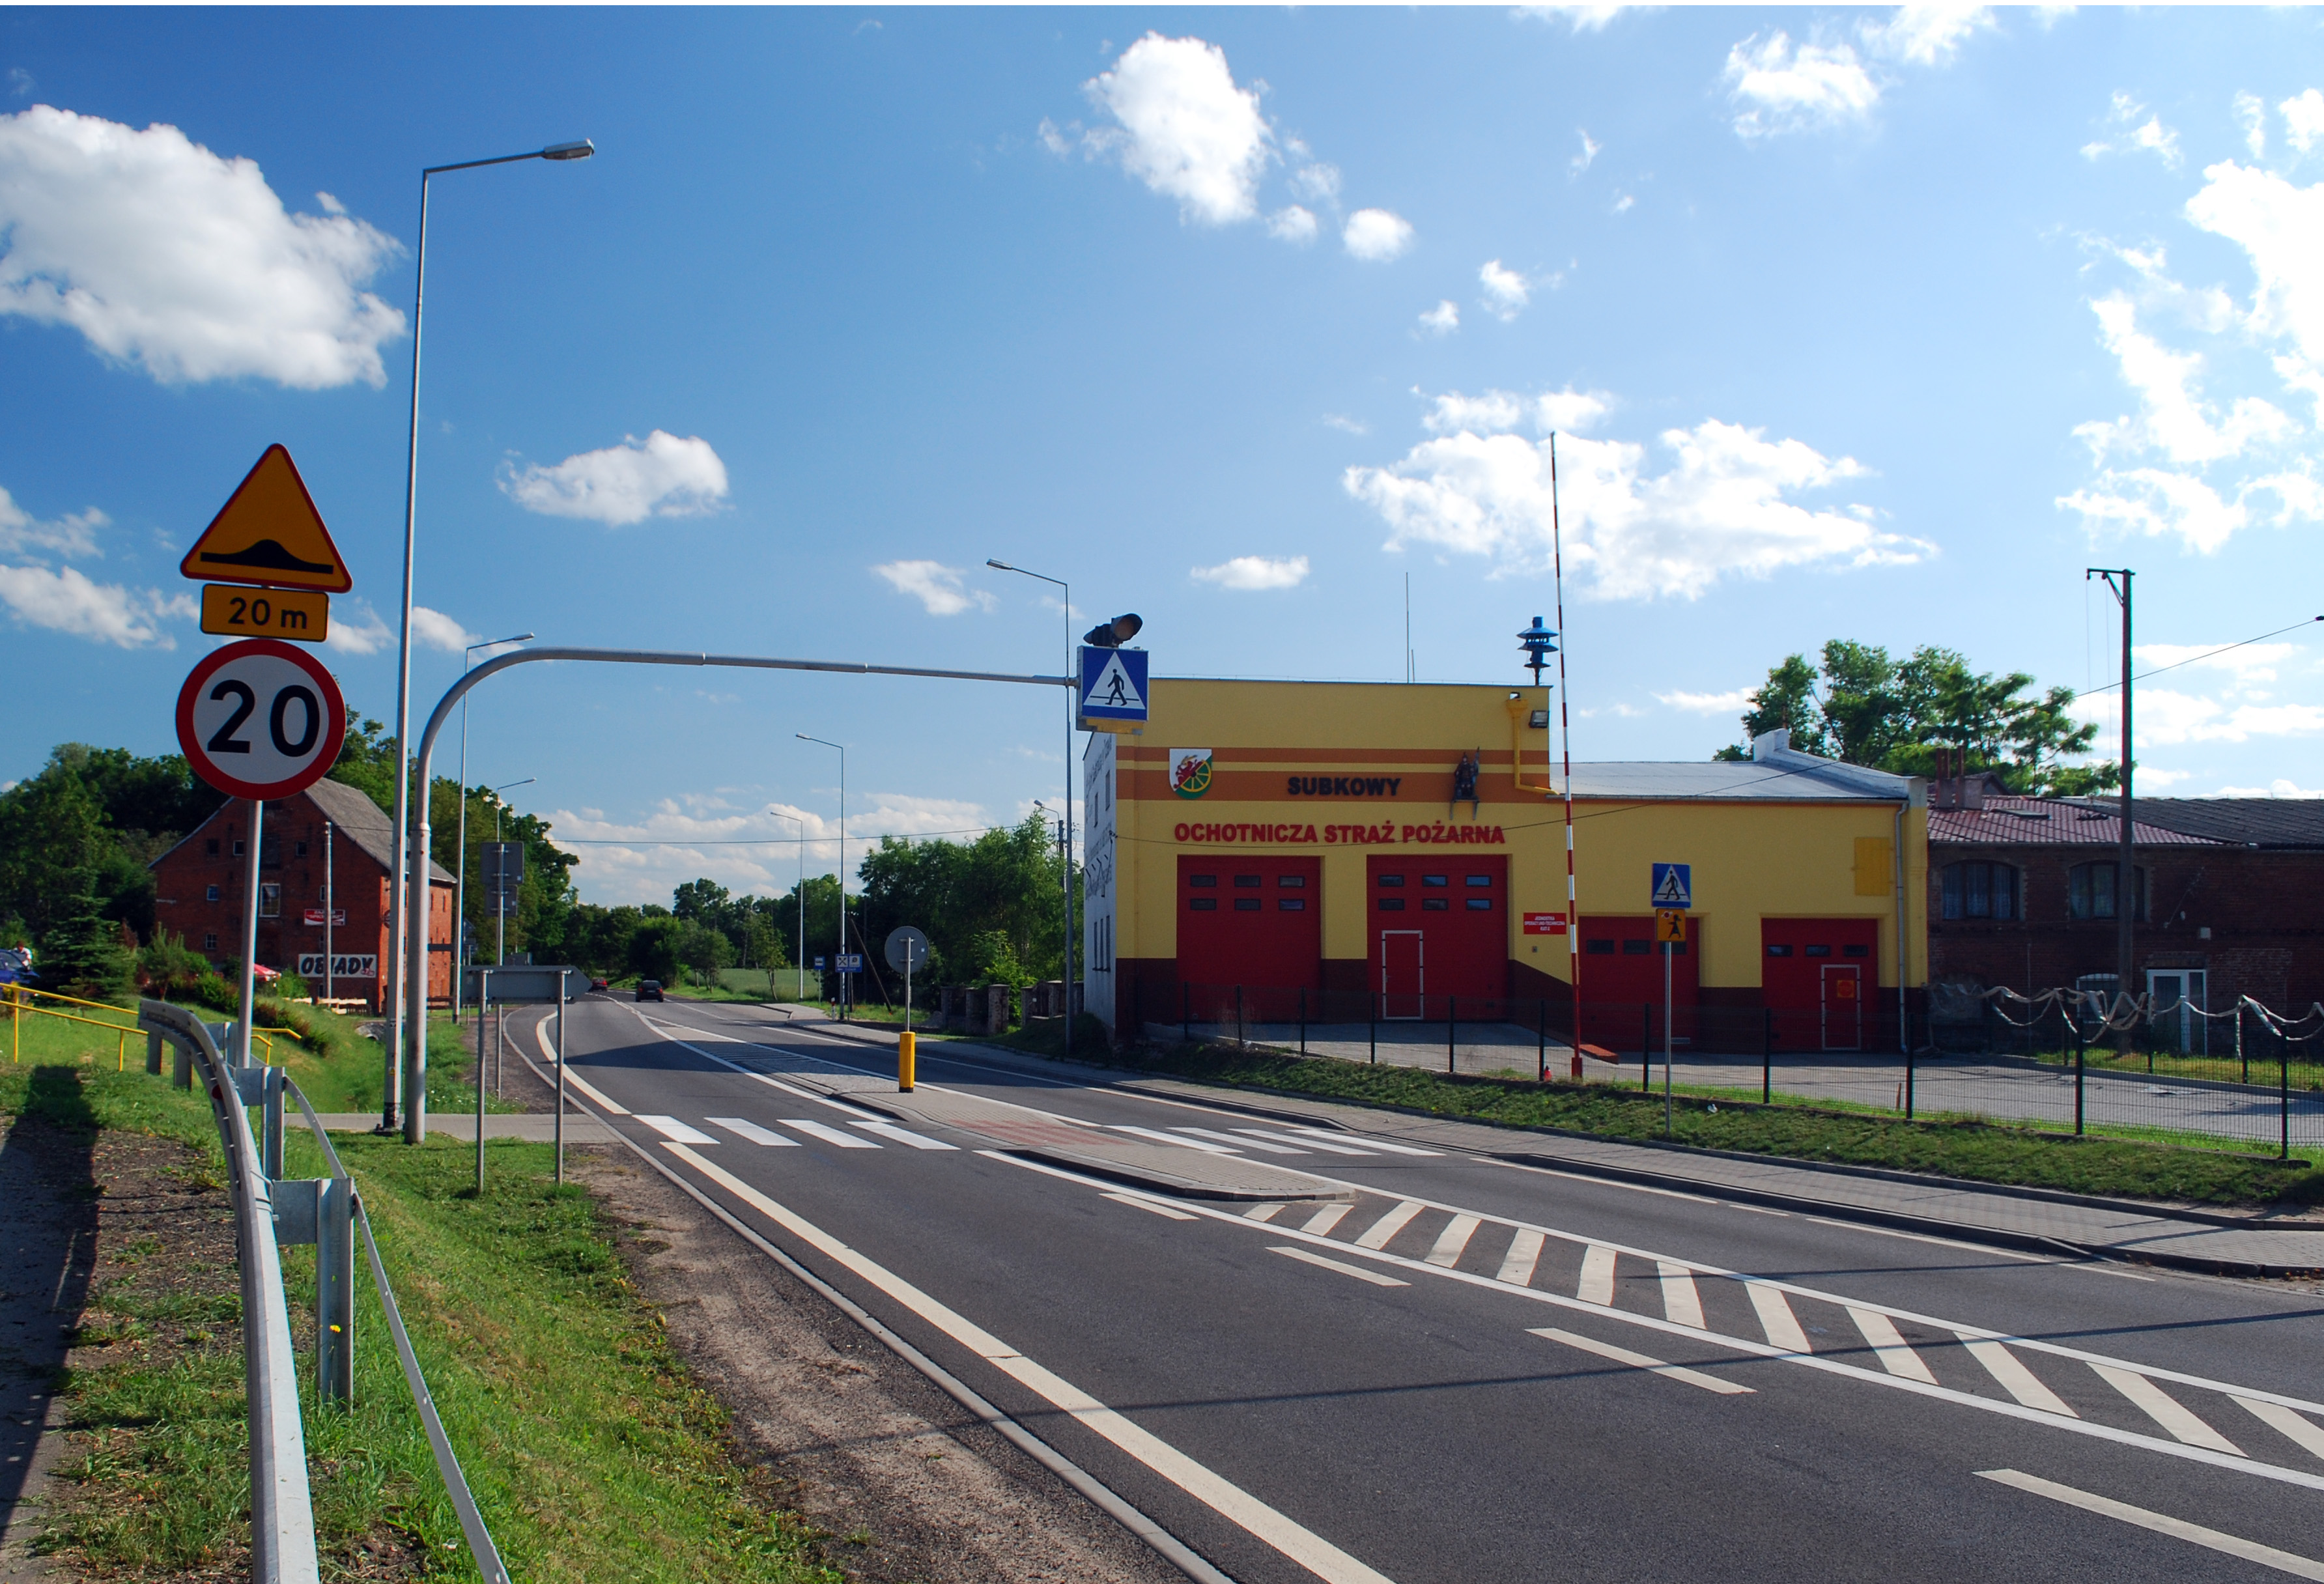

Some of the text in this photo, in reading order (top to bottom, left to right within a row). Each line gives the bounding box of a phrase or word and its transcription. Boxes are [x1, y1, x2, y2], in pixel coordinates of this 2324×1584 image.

[229, 597, 307, 629] 20 m
[207, 679, 320, 757] 20
[1288, 777, 1401, 796] SUBKOWY
[1174, 820, 1506, 843] OCHOTNICZA STRAŻ POŻARNA
